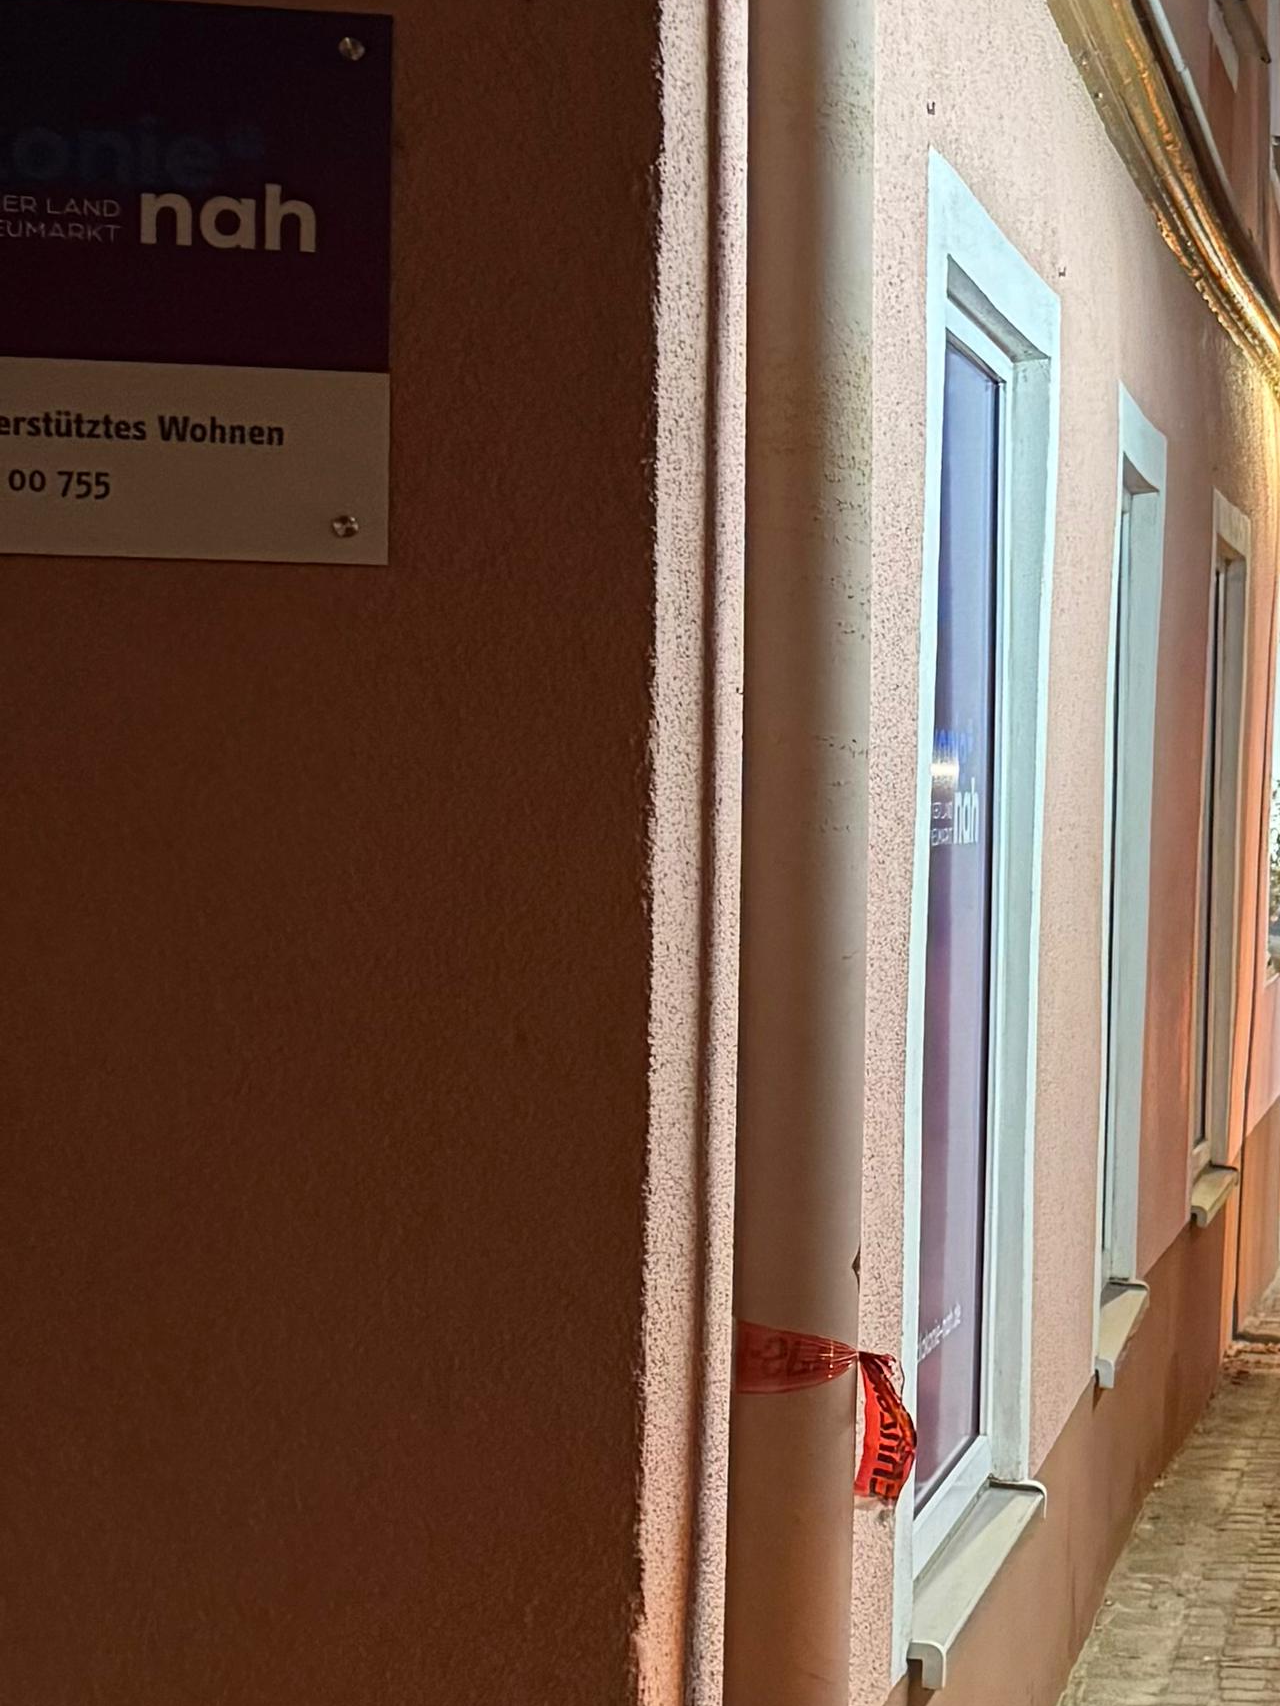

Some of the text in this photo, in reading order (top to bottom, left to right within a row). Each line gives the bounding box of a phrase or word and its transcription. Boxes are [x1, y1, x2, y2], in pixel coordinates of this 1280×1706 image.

[46, 197, 121, 218] LAND
[140, 183, 316, 253] nah
[158, 414, 285, 447] Wohnen
[8, 469, 111, 500] 00 755
[953, 777, 980, 844] nah
